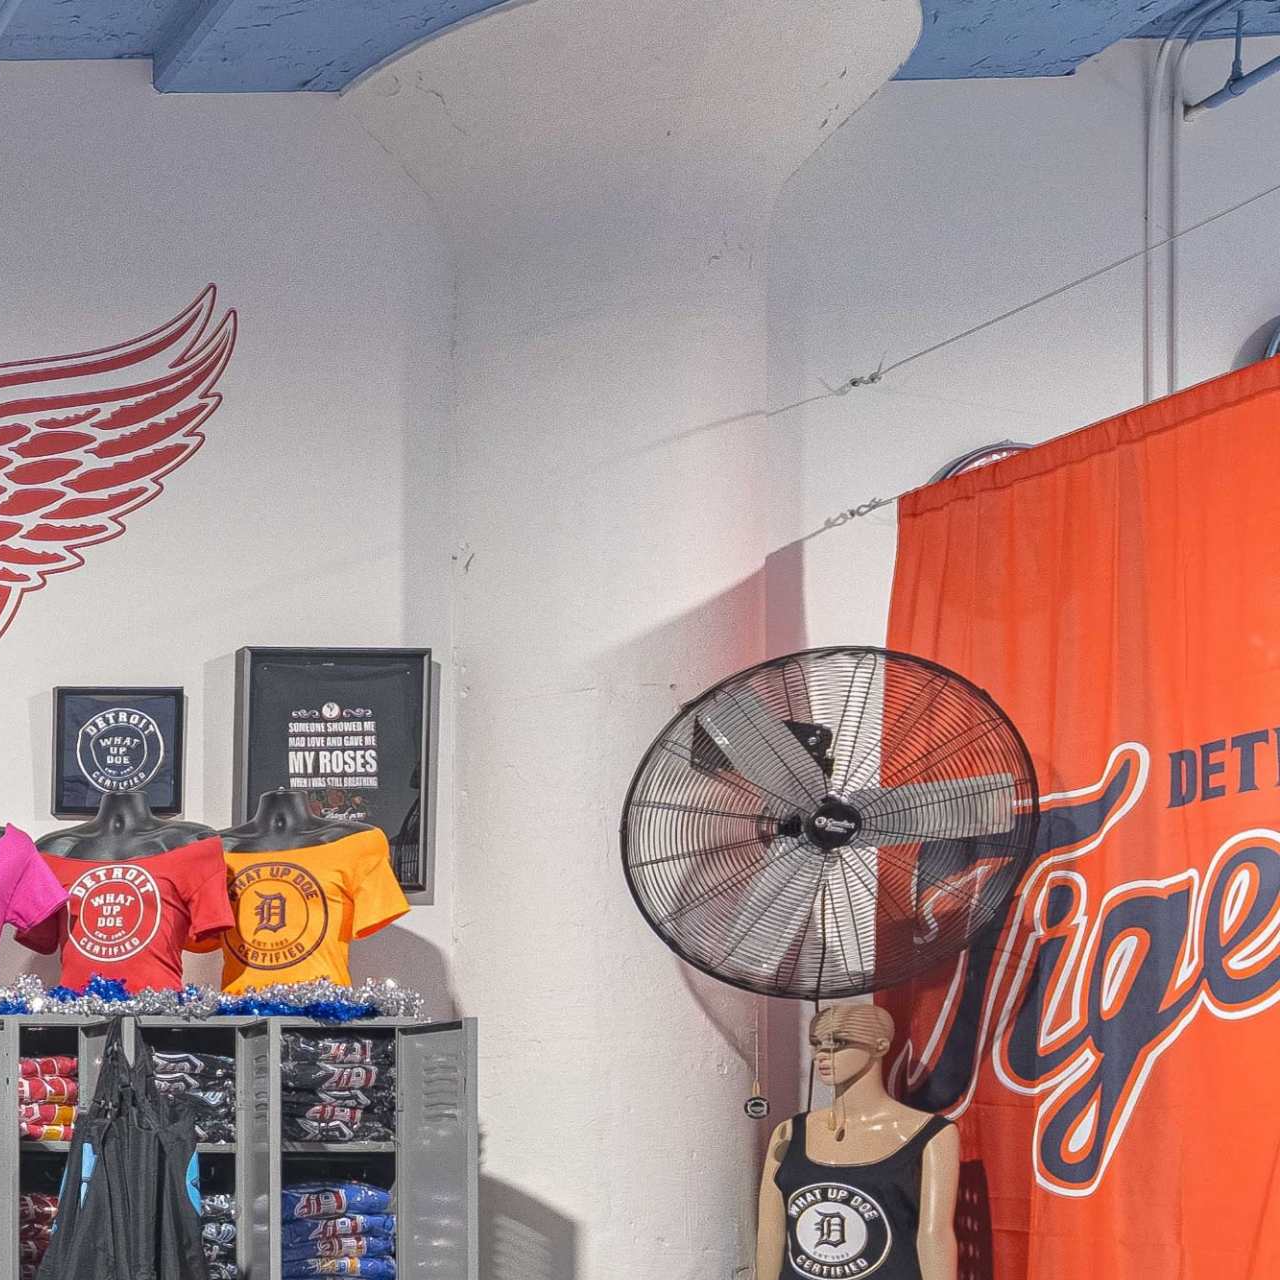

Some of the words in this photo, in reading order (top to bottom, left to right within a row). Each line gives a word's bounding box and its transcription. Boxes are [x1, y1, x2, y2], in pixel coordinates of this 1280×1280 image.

[85, 711, 155, 736] DETROIT
[288, 722, 326, 733] SOMEONE
[326, 721, 363, 733] SHOWED
[363, 721, 377, 732] ME
[99, 736, 140, 748] WHAT
[109, 746, 127, 755] UP
[288, 736, 306, 748] MAD
[306, 736, 326, 747] LOVE
[326, 736, 343, 747] AND
[343, 736, 363, 747] GAVE
[364, 735, 377, 746] ME
[106, 755, 131, 764] DOE
[288, 751, 316, 774] MY
[318, 749, 378, 774] ROSES
[92, 771, 146, 790] CERTIFIED
[72, 867, 154, 899] DETROIT
[269, 867, 292, 879] UP
[292, 872, 320, 901] DOE
[90, 893, 136, 908] WHAT
[102, 905, 121, 916] UP
[97, 916, 124, 928] DOE
[79, 936, 141, 957] CERTIFIED
[238, 941, 306, 964] CERTIFIED
[789, 1188, 823, 1219] WHAT
[827, 1187, 849, 1201] UP
[850, 1195, 880, 1222] DOE
[795, 1254, 869, 1278] CERTIFIED
